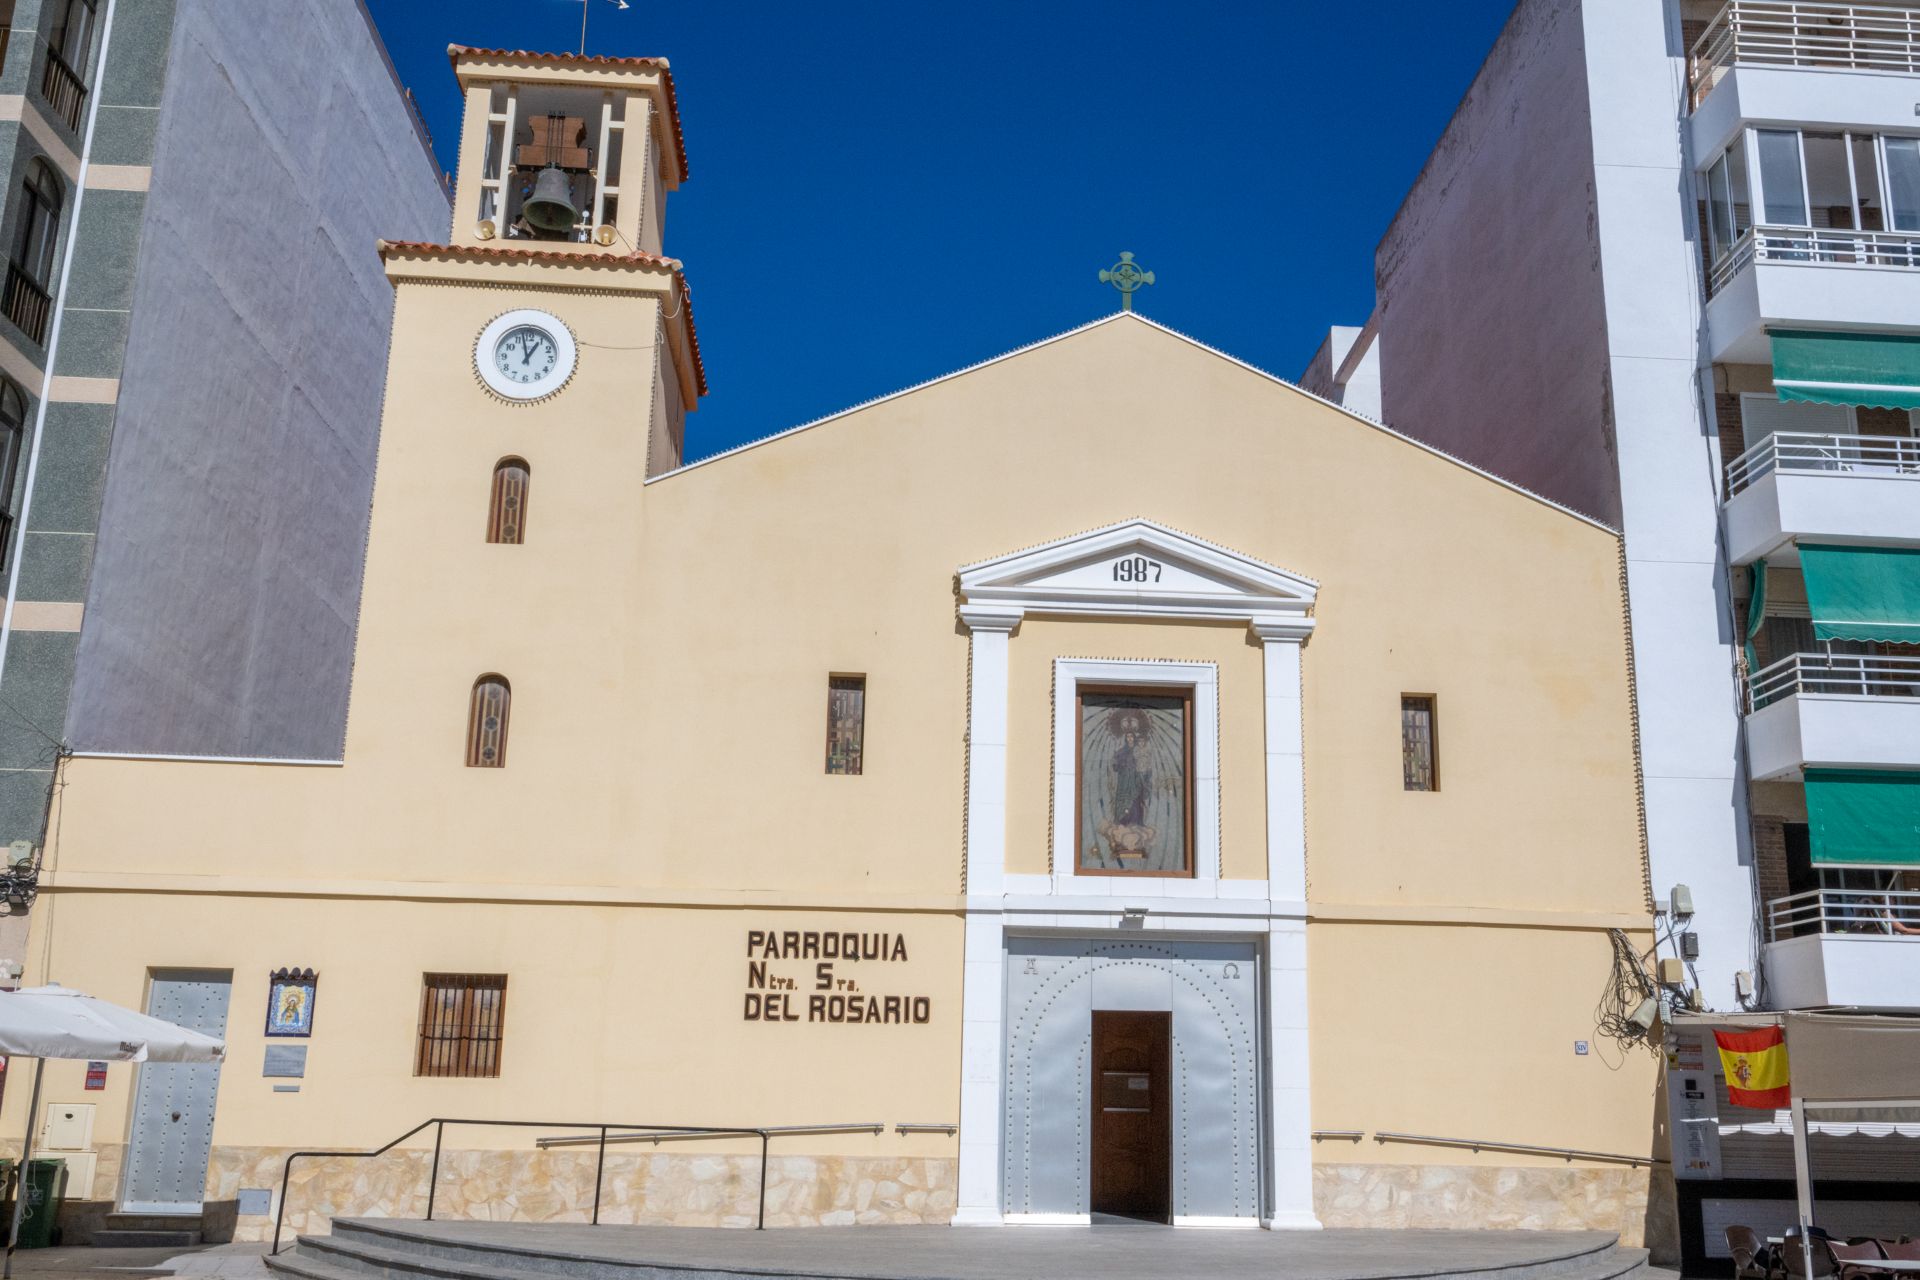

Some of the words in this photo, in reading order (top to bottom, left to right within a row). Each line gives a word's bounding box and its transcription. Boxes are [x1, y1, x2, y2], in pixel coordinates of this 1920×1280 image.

[515, 336, 521, 344] 11
[525, 333, 535, 342] 12
[547, 356, 554, 364] 3
[512, 371, 518, 379] 7
[1113, 557, 1162, 583] 1987
[747, 930, 908, 962] PARROQUIA
[748, 961, 798, 990] Ntra.
[816, 963, 859, 992] Sra.
[744, 993, 800, 1021] DEL
[808, 995, 930, 1024] ROSARIO
